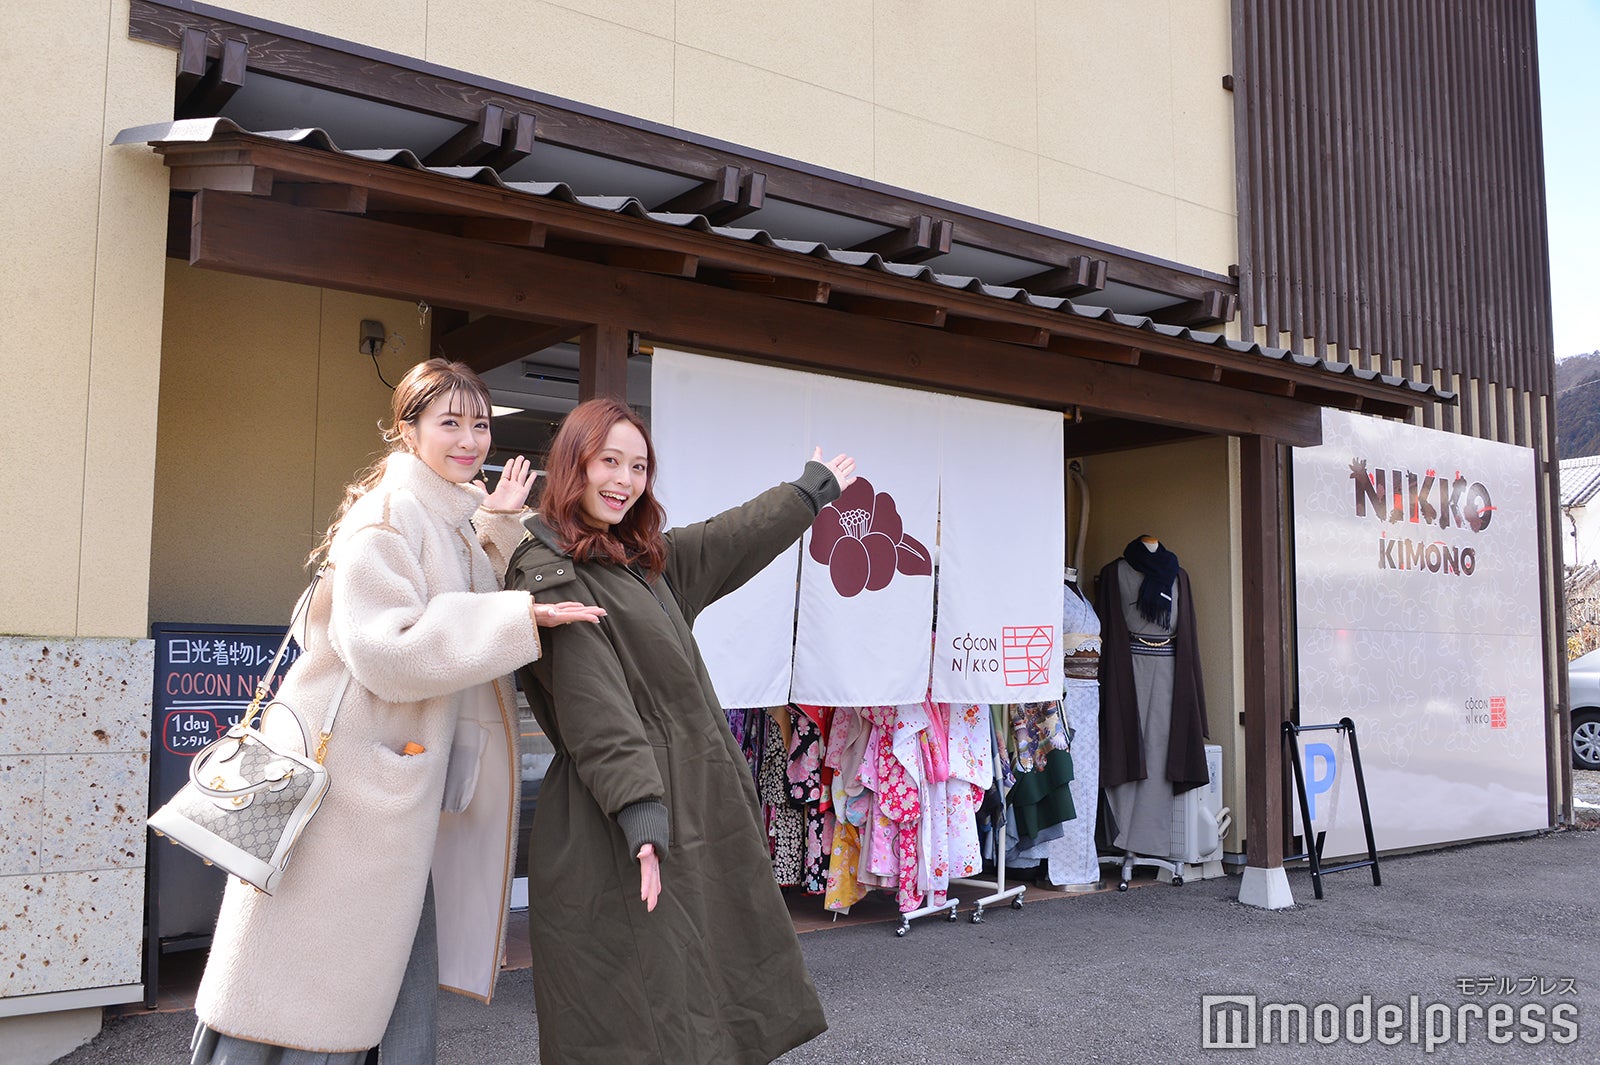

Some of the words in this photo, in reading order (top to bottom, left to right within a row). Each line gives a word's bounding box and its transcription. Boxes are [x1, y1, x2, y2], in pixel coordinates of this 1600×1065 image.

[1350, 458, 1496, 533] NIKKO
[1378, 534, 1476, 577] KIMONO
[952, 634, 997, 651] COCON
[951, 657, 999, 673] NIKKO
[166, 671, 231, 697] COCON
[1464, 698, 1489, 710] COCON
[171, 714, 210, 734] 1day
[172, 735, 212, 748] レンタル
[1304, 742, 1337, 821] P
